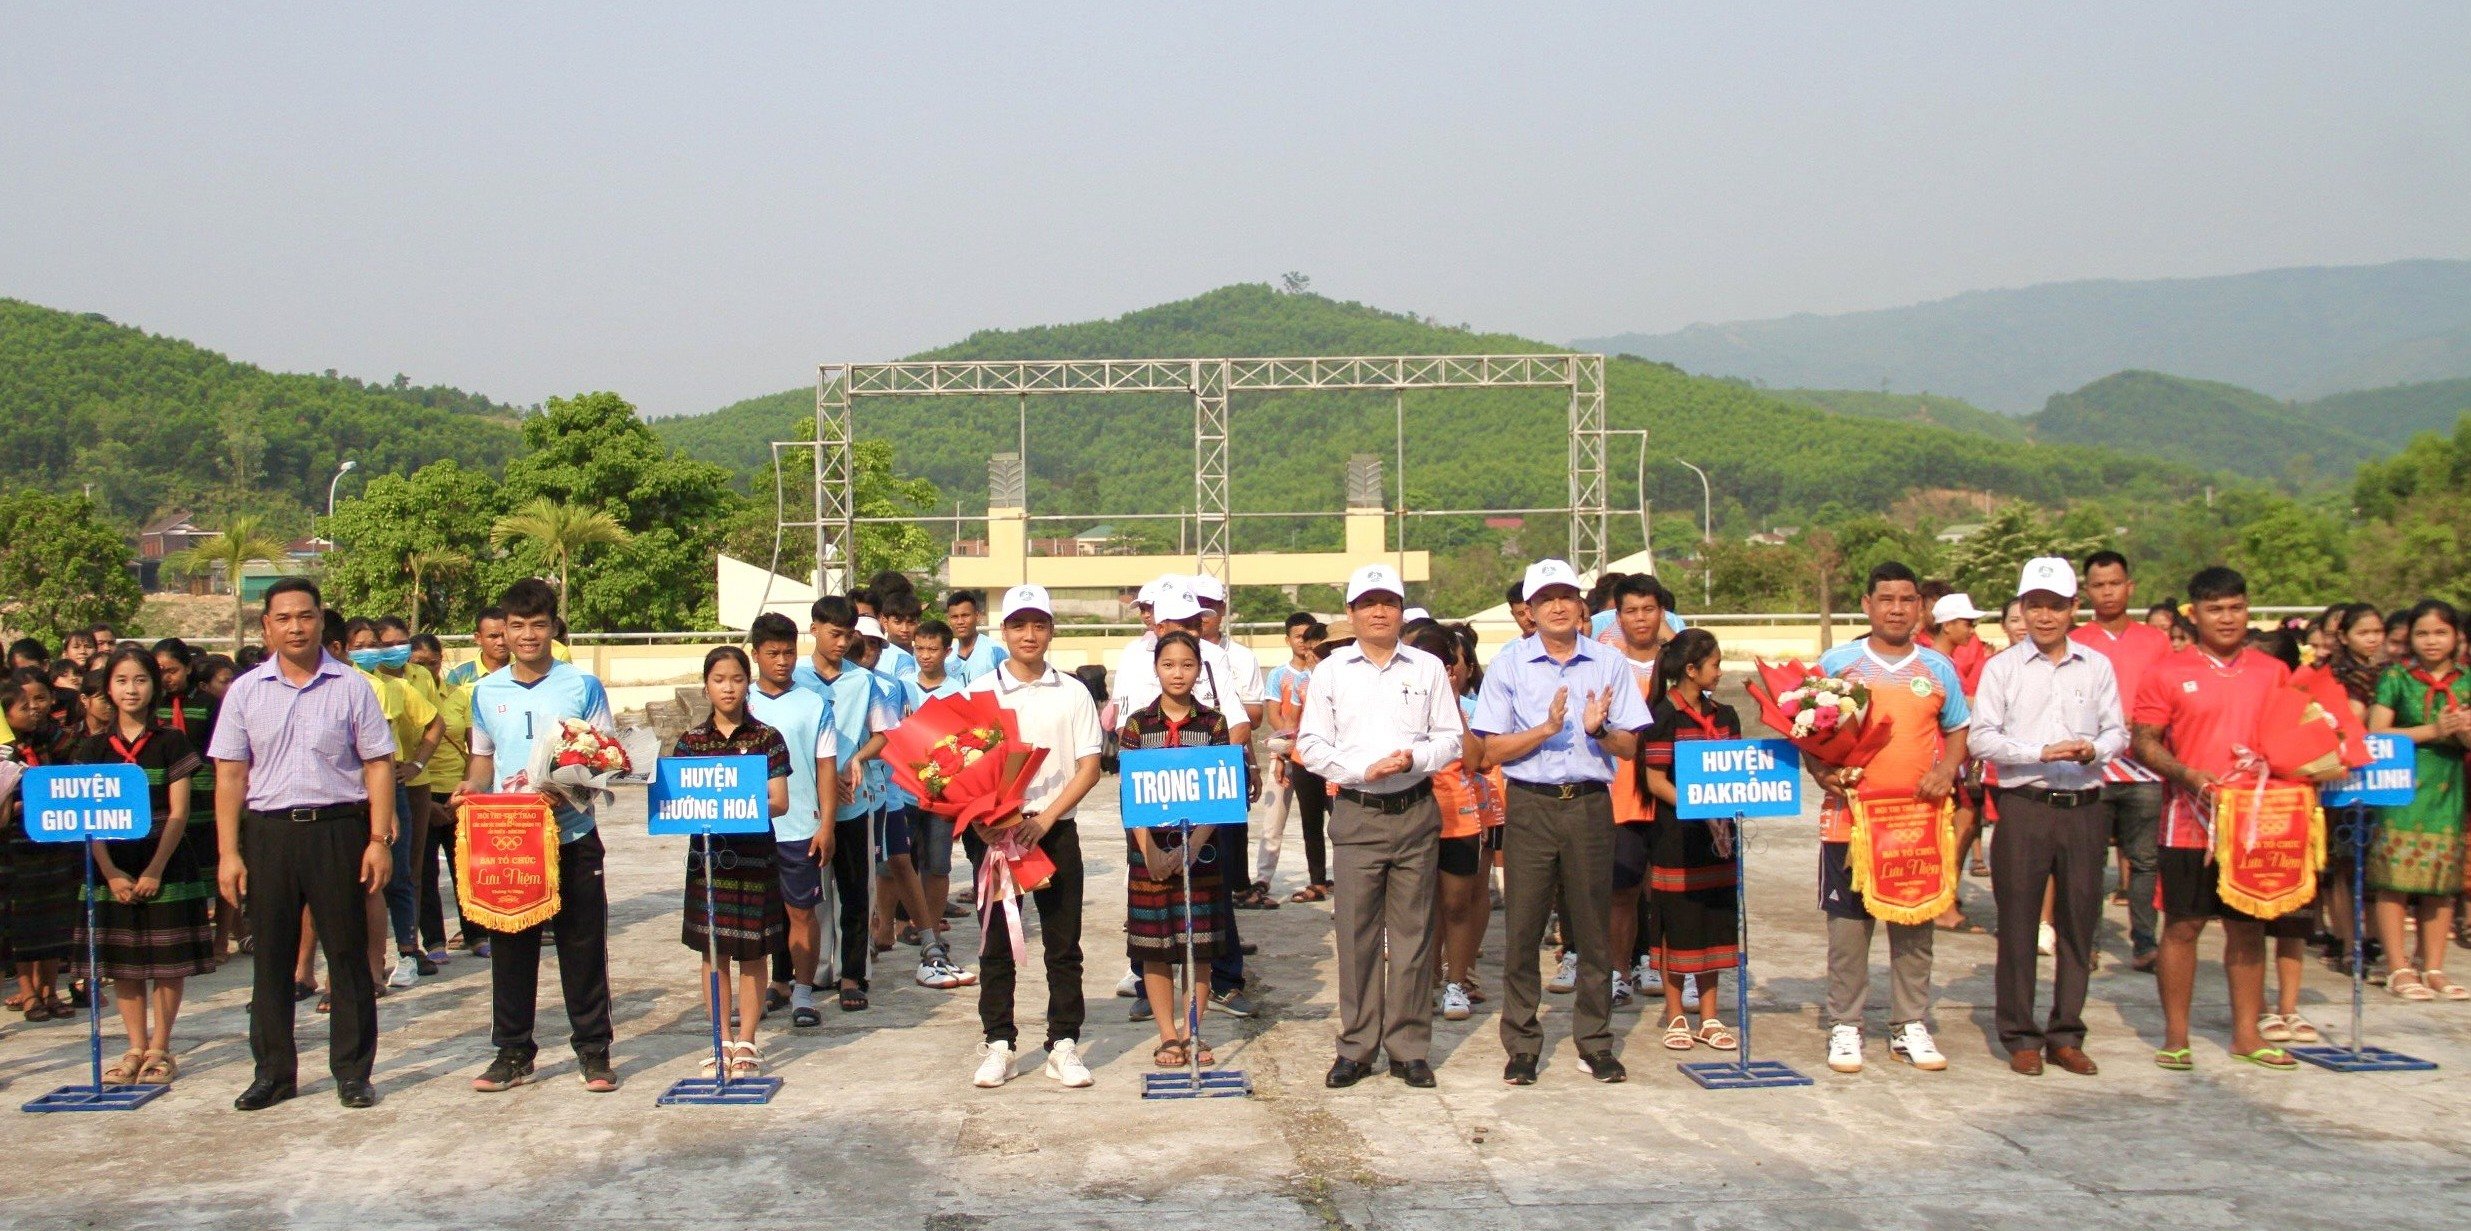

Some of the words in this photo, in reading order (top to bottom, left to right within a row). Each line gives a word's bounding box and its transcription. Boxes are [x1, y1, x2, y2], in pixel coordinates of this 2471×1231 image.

[525, 711, 533, 739] 1
[1702, 745, 1775, 775] HUYỆN
[50, 773, 121, 803] HUYỆN
[680, 762, 738, 792] HUYỆN
[1131, 768, 1200, 810] TRỌNG
[1204, 759, 1238, 800] TÀI
[1687, 777, 1793, 805] ĐAKRÔNG
[2366, 768, 2412, 790] LINH
[42, 809, 78, 831] GIO
[84, 809, 133, 830] LINH
[659, 795, 718, 820] HƯỚNG
[723, 794, 759, 819] HOÁ
[480, 856, 496, 865] BAN
[476, 868, 502, 885] Lưu
[503, 868, 542, 887] Niệm
